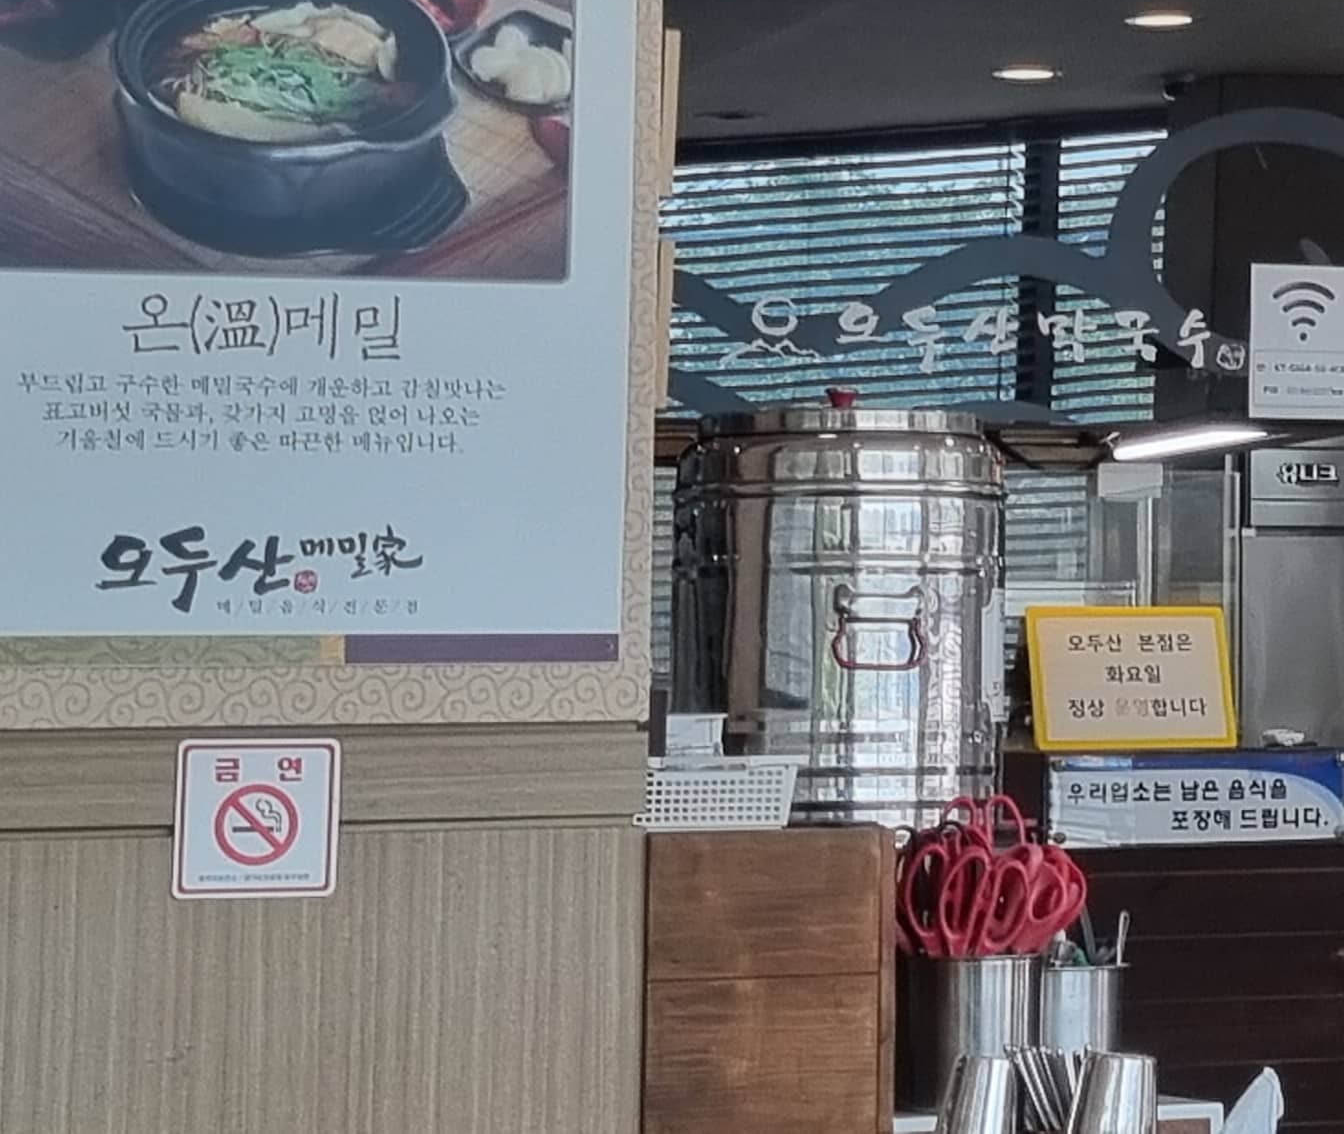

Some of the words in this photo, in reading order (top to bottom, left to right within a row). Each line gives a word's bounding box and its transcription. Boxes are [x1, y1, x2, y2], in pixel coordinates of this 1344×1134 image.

[835, 302, 1213, 375] 오두산막국수
[17, 372, 108, 395] 부드럽고
[116, 373, 186, 396] 구수한
[190, 374, 299, 398] 메밀국수에
[309, 375, 393, 398] 개운하고
[402, 376, 507, 400] 감칠맛나는
[42, 400, 132, 423] 표고버섯
[223, 401, 286, 424] 갖가지
[295, 402, 360, 426] 고명을
[368, 403, 408, 427] 얹어
[417, 405, 481, 427] 나오는
[153, 428, 219, 451] 드시기
[228, 430, 270, 452] 좋은
[279, 430, 342, 453] 따끈한
[351, 431, 465, 454] 메뉴입니다.
[95, 525, 296, 614] 오두산
[1067, 633, 1123, 654] 오두산
[1137, 633, 1193, 653] 본점은
[1105, 664, 1163, 685] 화요일
[1067, 697, 1105, 719] 정상
[215, 757, 240, 783] 금
[277, 757, 303, 783] 연
[1067, 781, 1173, 805] 우리업소는
[1180, 779, 1220, 802] 남은
[1228, 778, 1288, 801] 음식을
[1170, 809, 1232, 832] 포장해
[1239, 806, 1330, 830] 드립니다.
